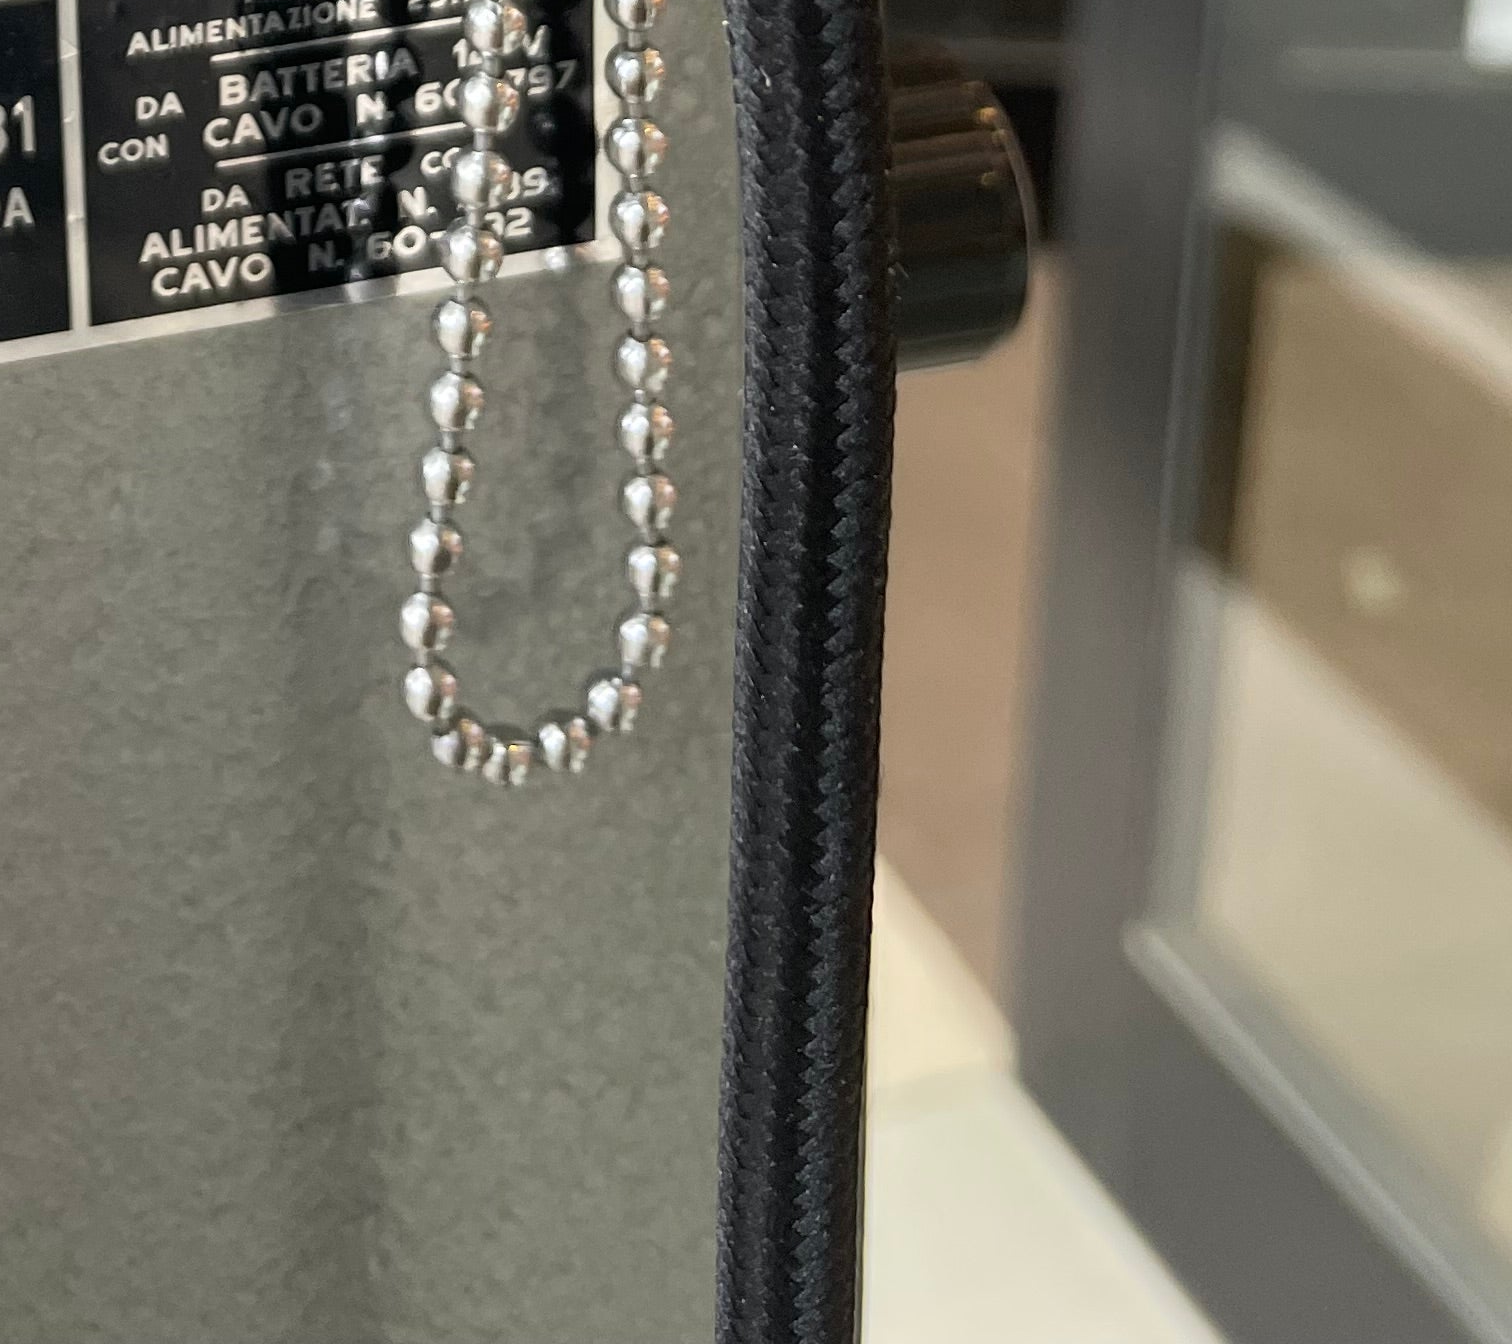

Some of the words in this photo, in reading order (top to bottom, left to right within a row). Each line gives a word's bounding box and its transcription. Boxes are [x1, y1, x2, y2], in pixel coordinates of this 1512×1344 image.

[135, 91, 184, 120] DA
[219, 47, 419, 106] BATTERIA
[98, 133, 170, 165] CON
[203, 103, 324, 147] CAVO
[200, 184, 249, 213] DA
[285, 154, 384, 198] RETE
[152, 252, 273, 296] CAVO
